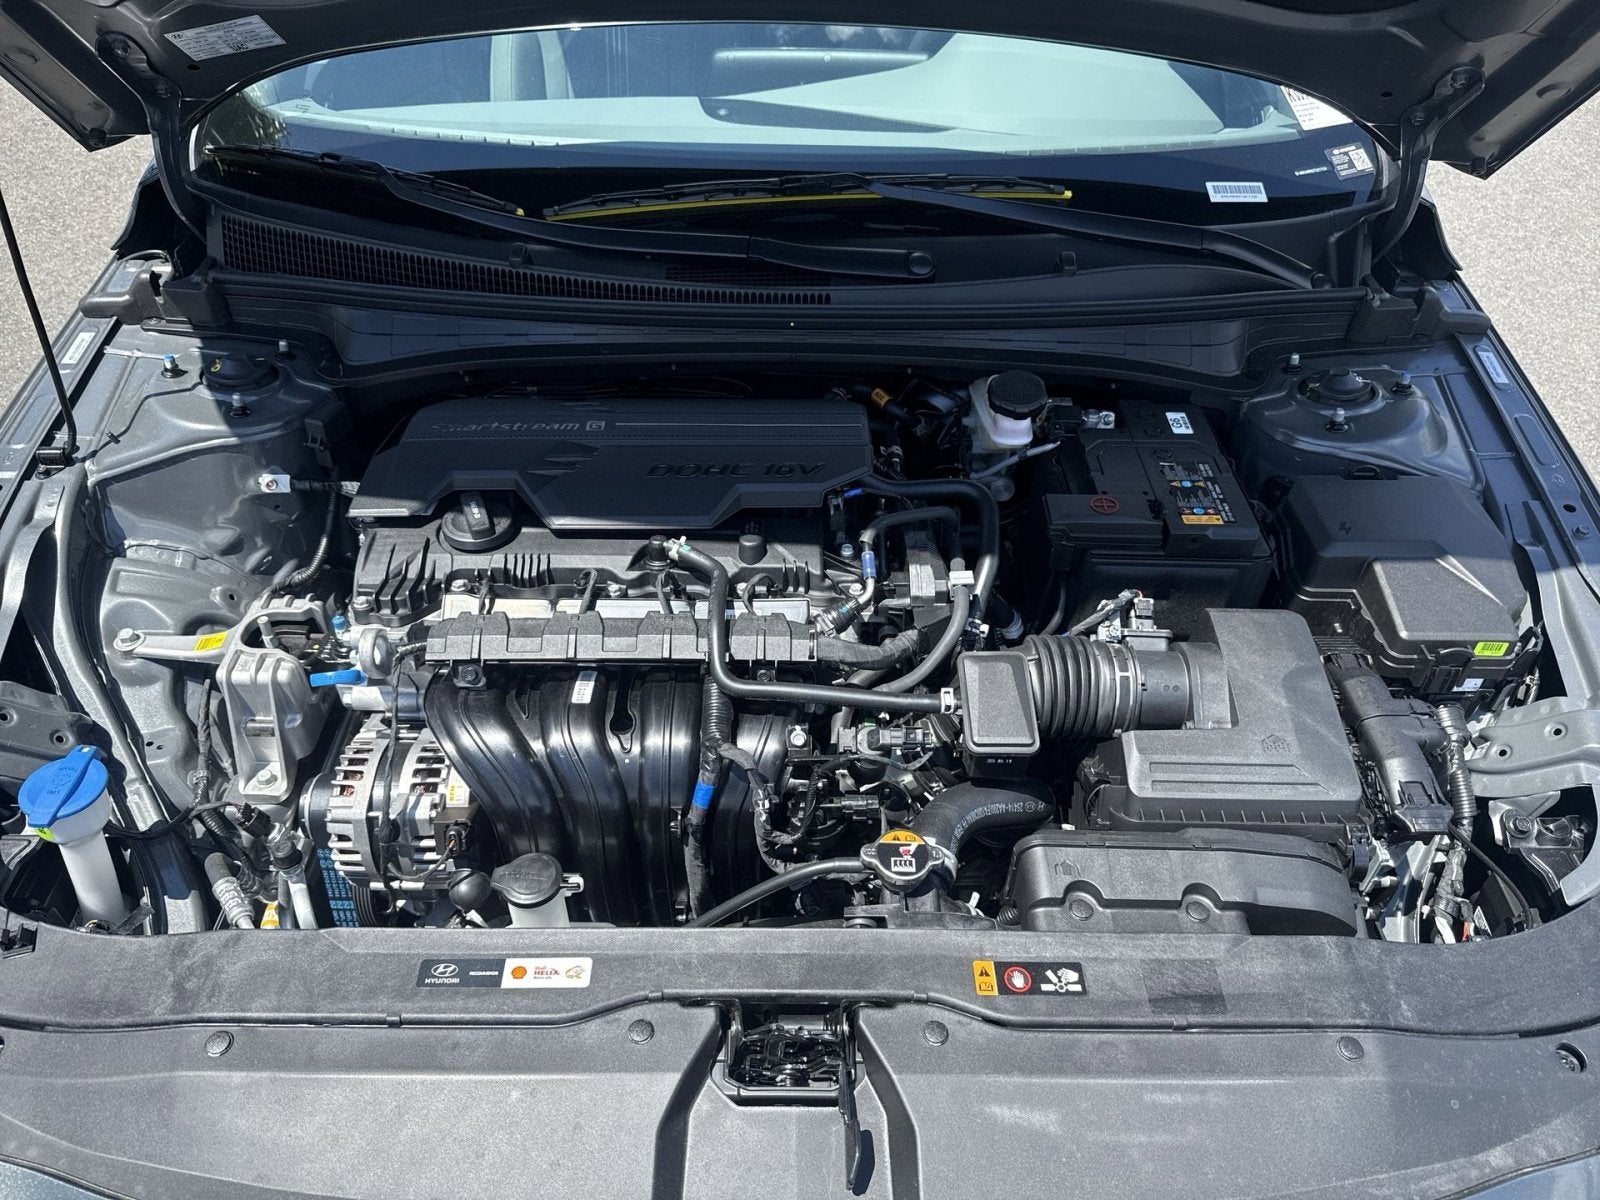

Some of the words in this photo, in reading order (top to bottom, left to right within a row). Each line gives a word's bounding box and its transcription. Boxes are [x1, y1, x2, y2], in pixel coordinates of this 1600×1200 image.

[646, 463, 754, 478] DOHC
[763, 463, 828, 478] 16V
[533, 969, 561, 977] HELIX
